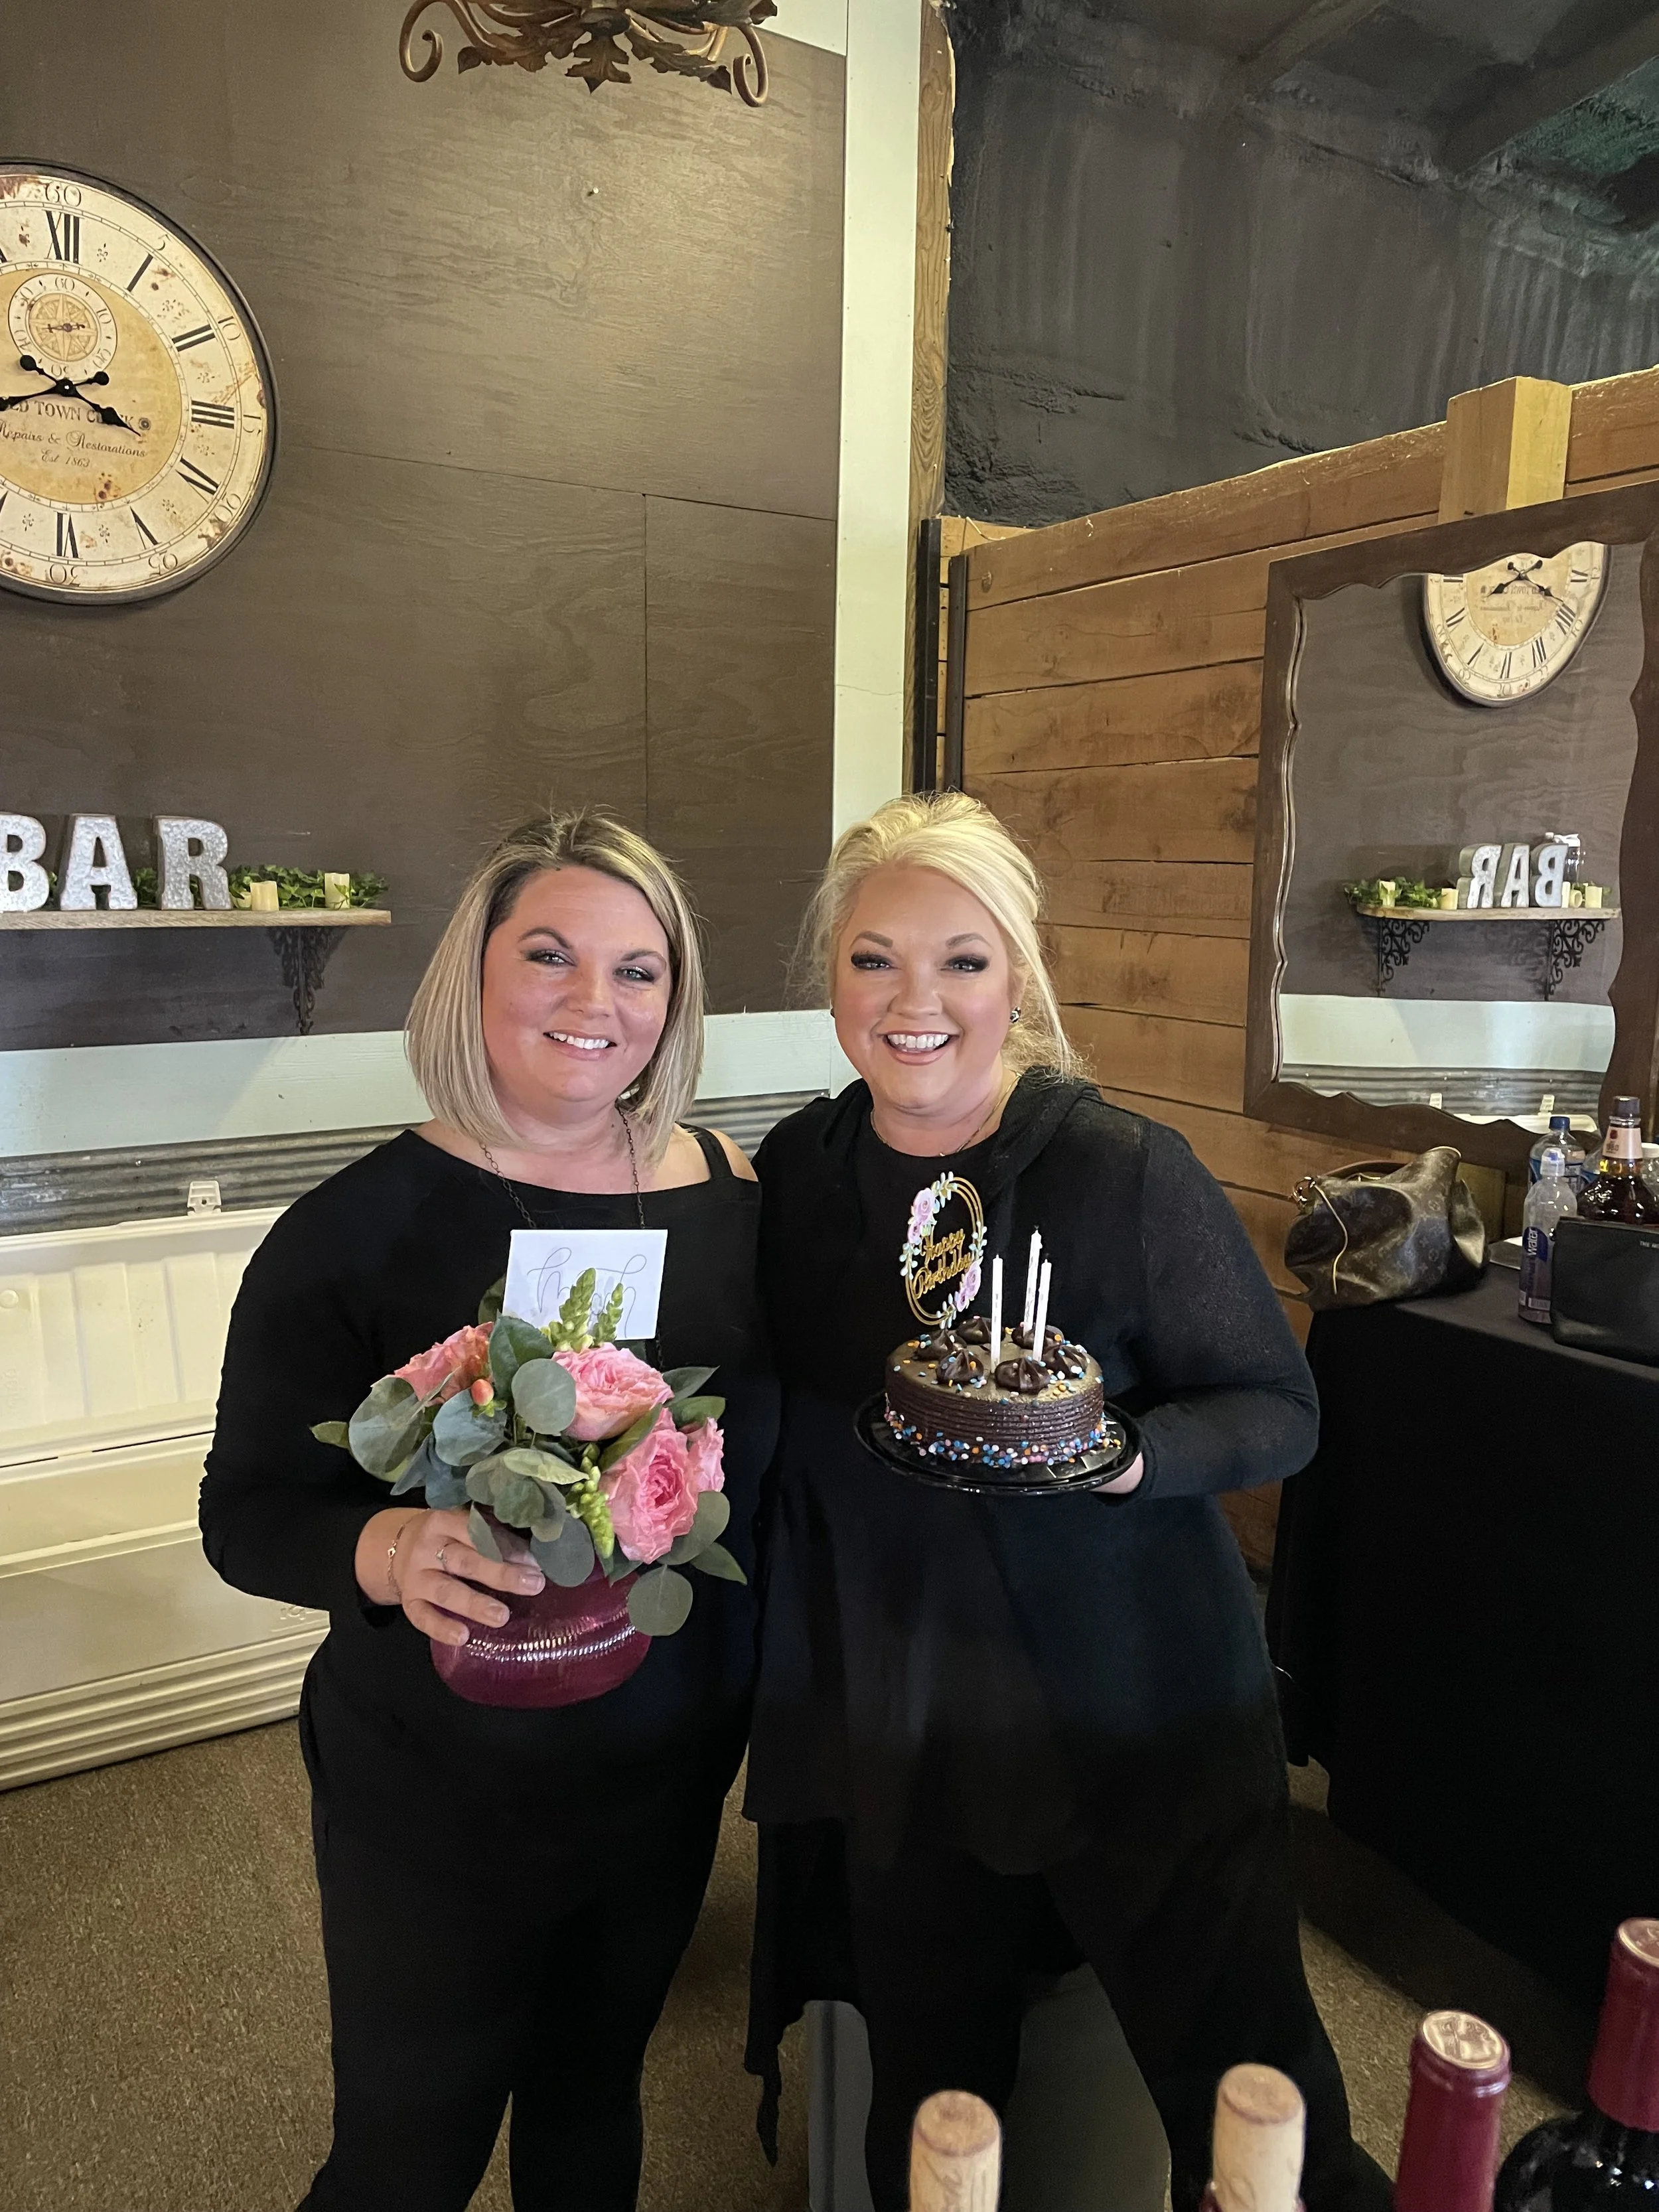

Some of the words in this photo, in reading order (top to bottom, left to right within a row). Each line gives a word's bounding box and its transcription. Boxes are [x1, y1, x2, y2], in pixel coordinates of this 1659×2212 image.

[45, 182, 82, 207] 60
[42, 209, 85, 266] XII
[169, 319, 219, 353] II
[218, 316, 241, 340] 10
[35, 400, 80, 421] TOWN
[190, 397, 235, 429] III
[243, 414, 261, 435] 15
[48, 433, 60, 444] &
[66, 430, 147, 457] Restorations
[65, 457, 90, 468] 1863
[0, 812, 232, 912] BAR
